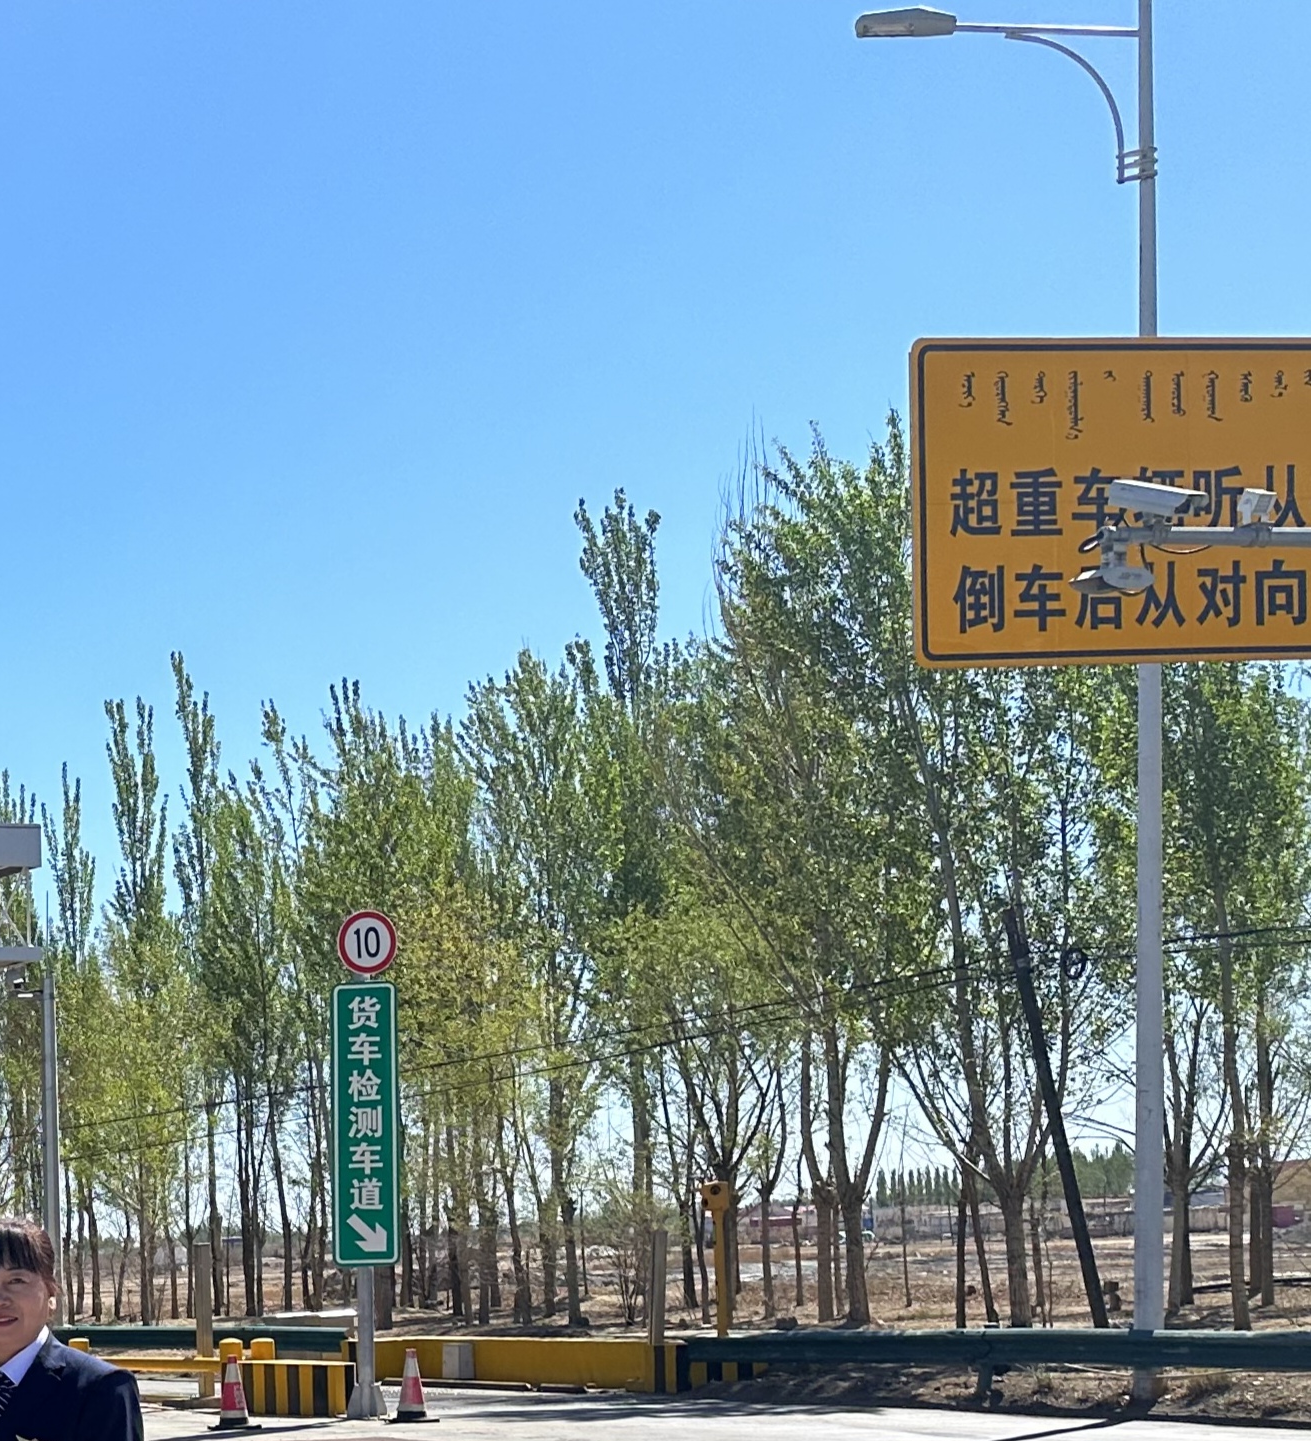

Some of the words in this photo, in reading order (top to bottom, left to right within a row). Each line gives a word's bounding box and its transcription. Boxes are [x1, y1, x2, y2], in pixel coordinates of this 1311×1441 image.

[353, 926, 380, 959] 10
[348, 996, 383, 1210] 货车检测车道
